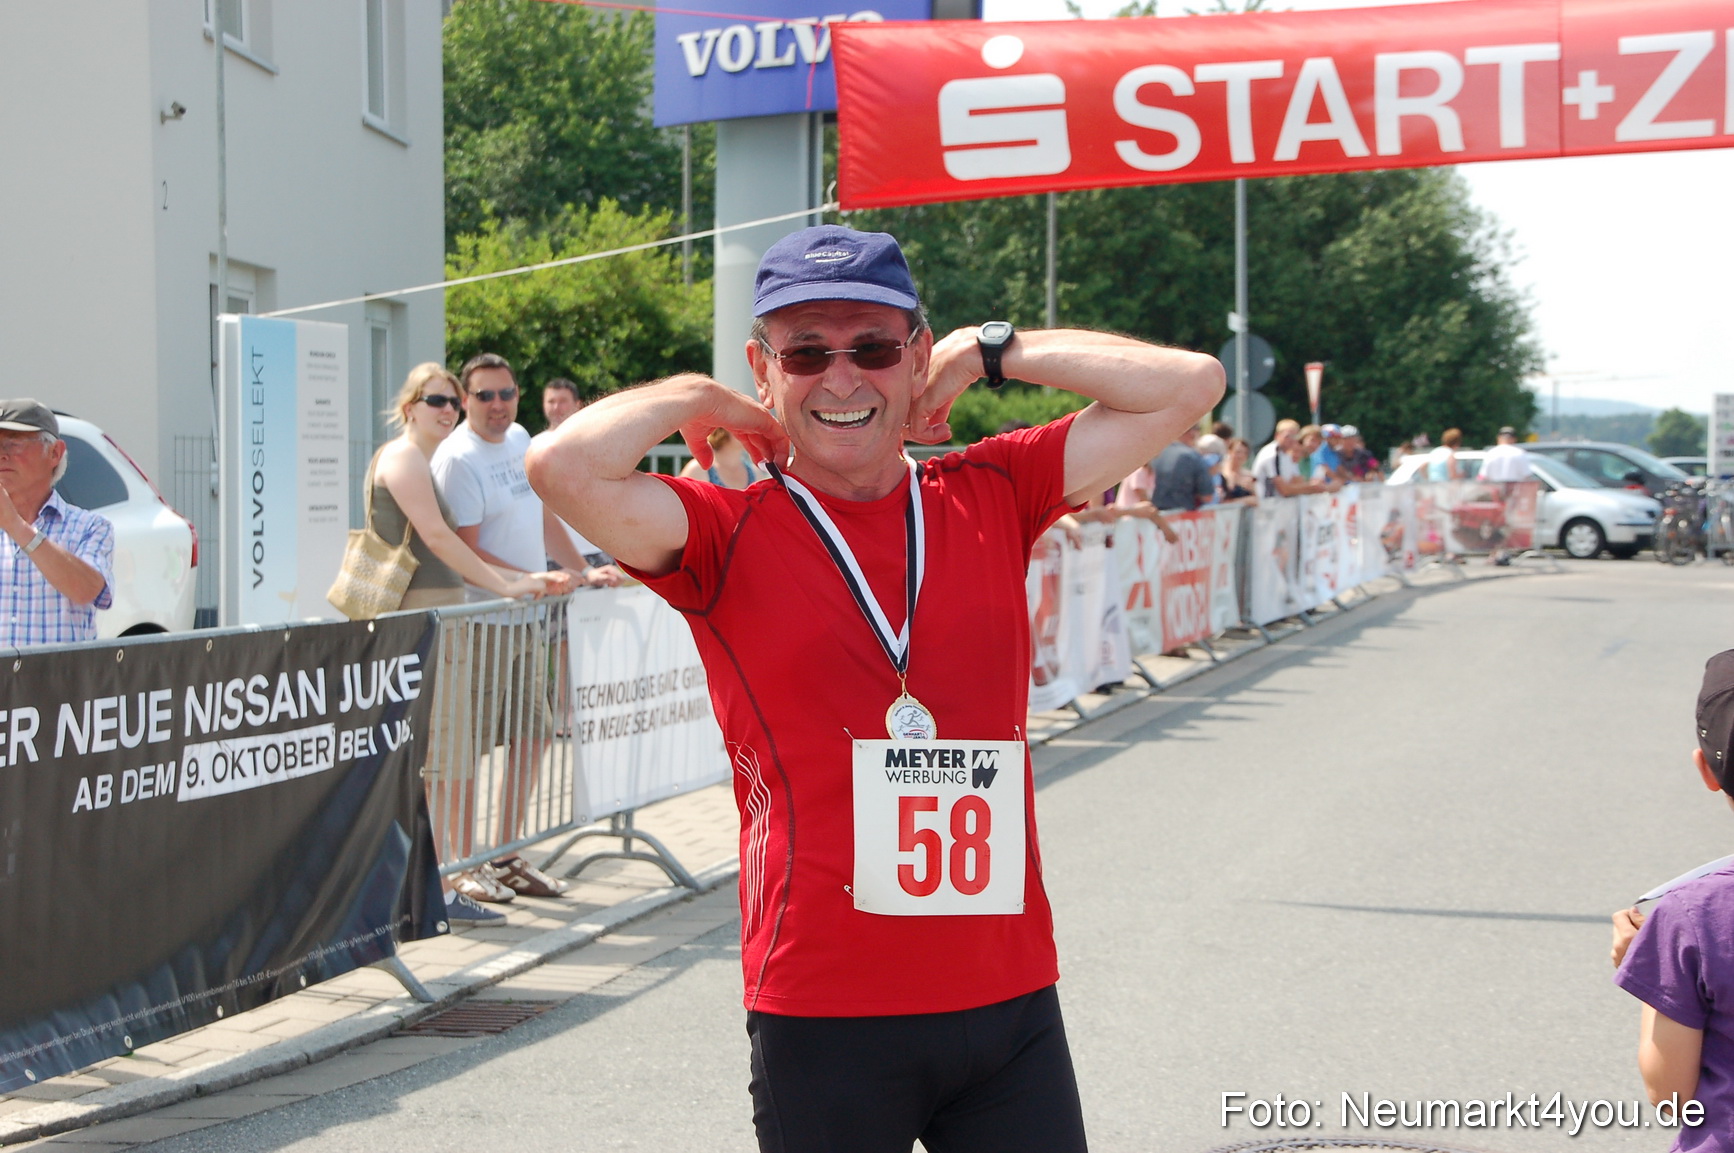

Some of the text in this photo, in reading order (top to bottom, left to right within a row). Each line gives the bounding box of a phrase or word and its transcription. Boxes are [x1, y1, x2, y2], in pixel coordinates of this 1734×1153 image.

[677, 11, 884, 77] VOLV
[54, 688, 172, 758] NEUE
[185, 667, 327, 737] NISSAN
[340, 654, 422, 713] JUKE
[577, 675, 655, 711] TECHNOLOGIE
[599, 714, 632, 742] NEUE
[72, 776, 113, 813] AB
[121, 761, 176, 803] DEM
[186, 758, 204, 788] 9.
[212, 736, 330, 783] OKTOBER
[339, 726, 377, 761] BEI
[885, 749, 966, 768] MEYER
[885, 770, 967, 784] WERBUNG
[898, 795, 992, 897] 58
